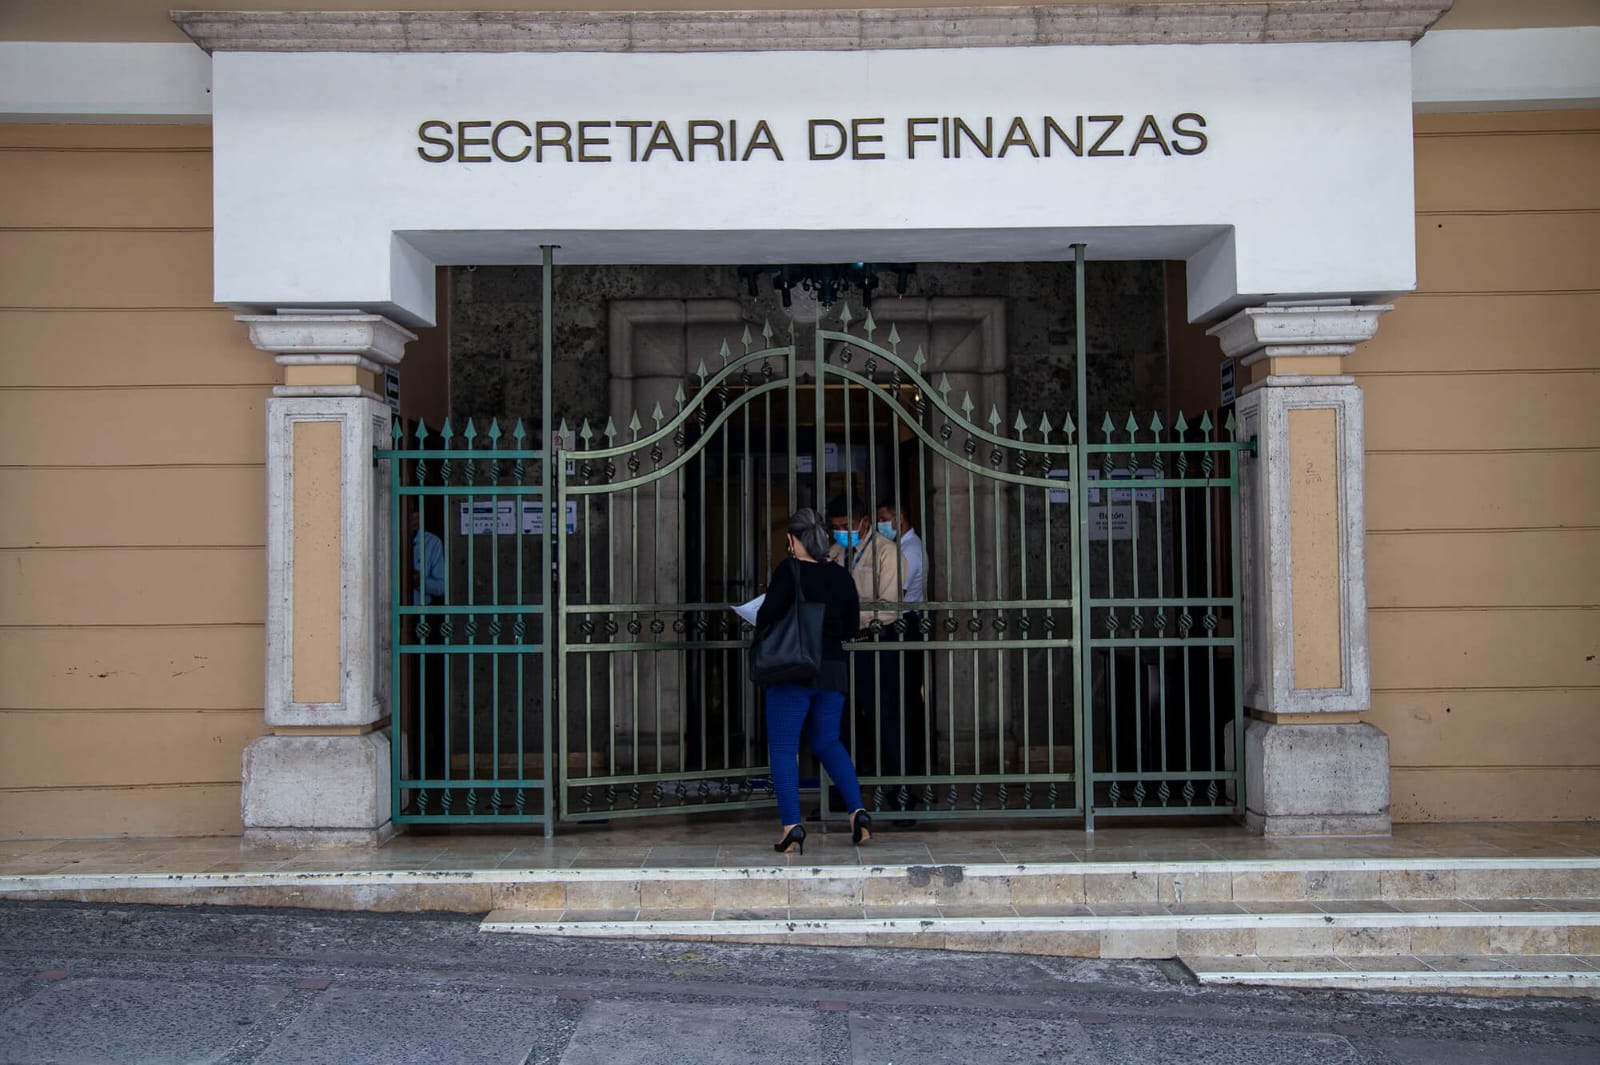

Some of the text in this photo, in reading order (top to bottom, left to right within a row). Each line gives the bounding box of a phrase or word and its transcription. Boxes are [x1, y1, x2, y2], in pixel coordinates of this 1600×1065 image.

[418, 112, 1208, 163] SECRETARIA DE FINANZAS
